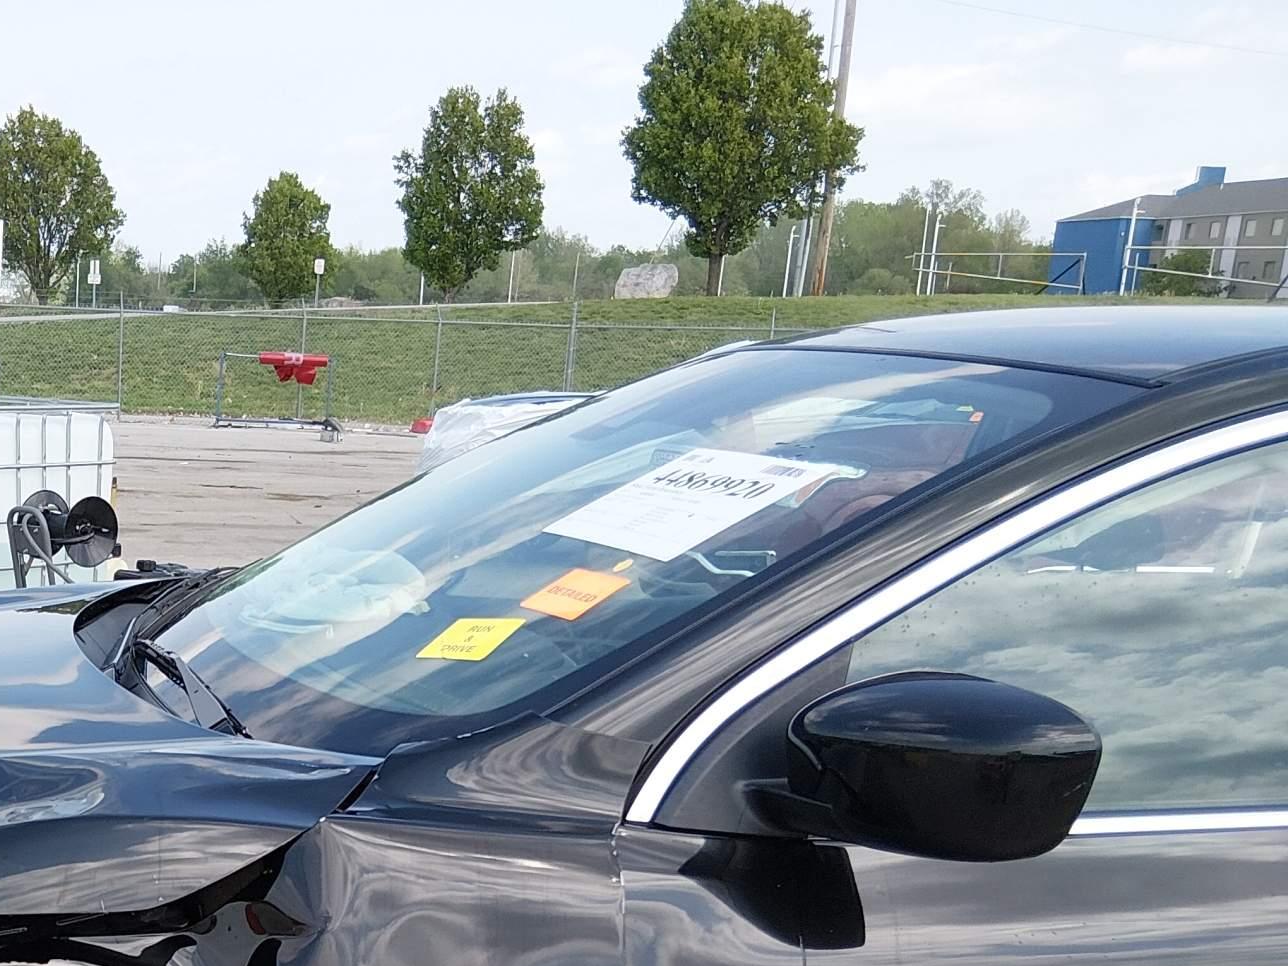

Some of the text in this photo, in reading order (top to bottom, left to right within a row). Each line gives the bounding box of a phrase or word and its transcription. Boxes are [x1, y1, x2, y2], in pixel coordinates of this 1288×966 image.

[654, 469, 775, 499] 44869920
[547, 586, 597, 602] DETAILED
[467, 625, 496, 633] RUN
[440, 645, 476, 653] DRIVE
